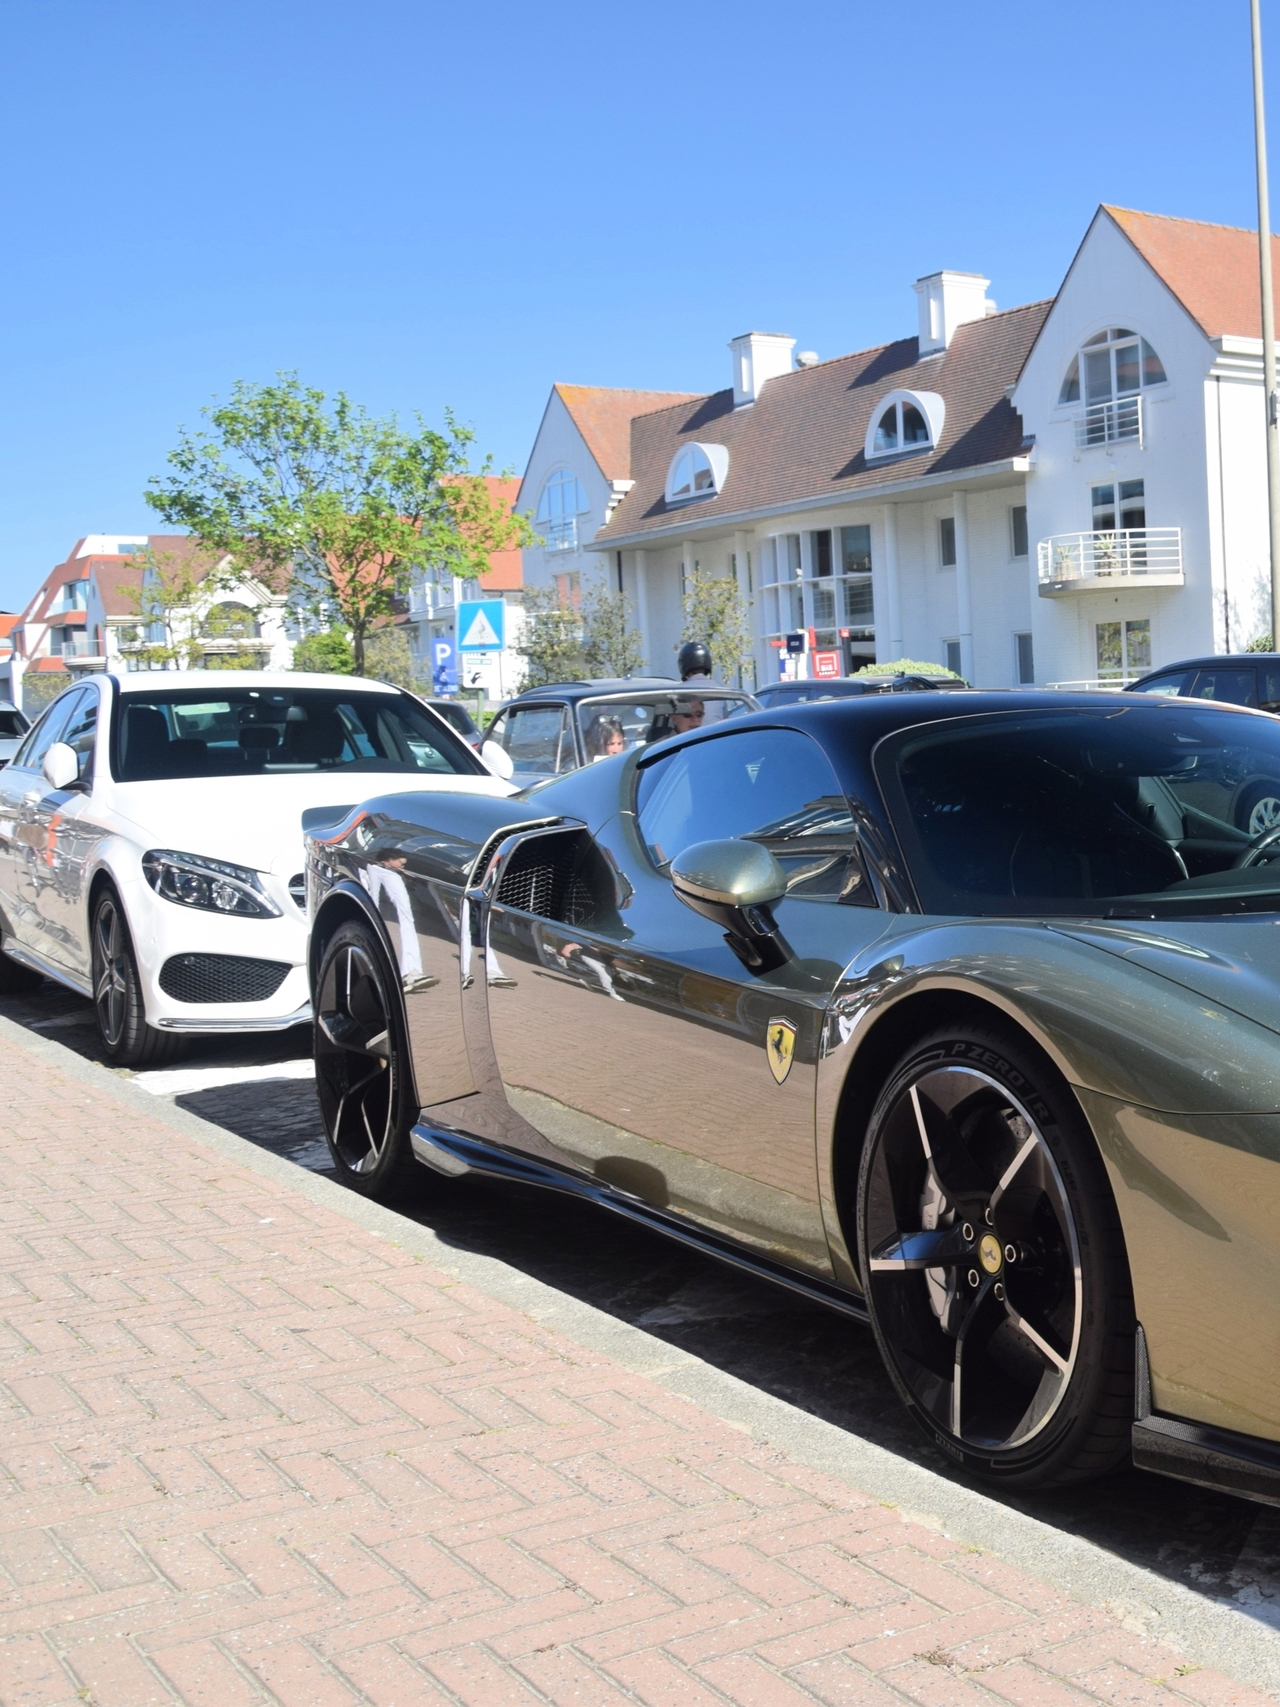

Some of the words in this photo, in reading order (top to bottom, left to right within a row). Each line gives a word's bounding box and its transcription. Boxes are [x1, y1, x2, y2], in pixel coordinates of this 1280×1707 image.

[435, 643, 451, 665] P
[951, 1043, 965, 1055] P
[967, 1045, 1025, 1087] ZERO
